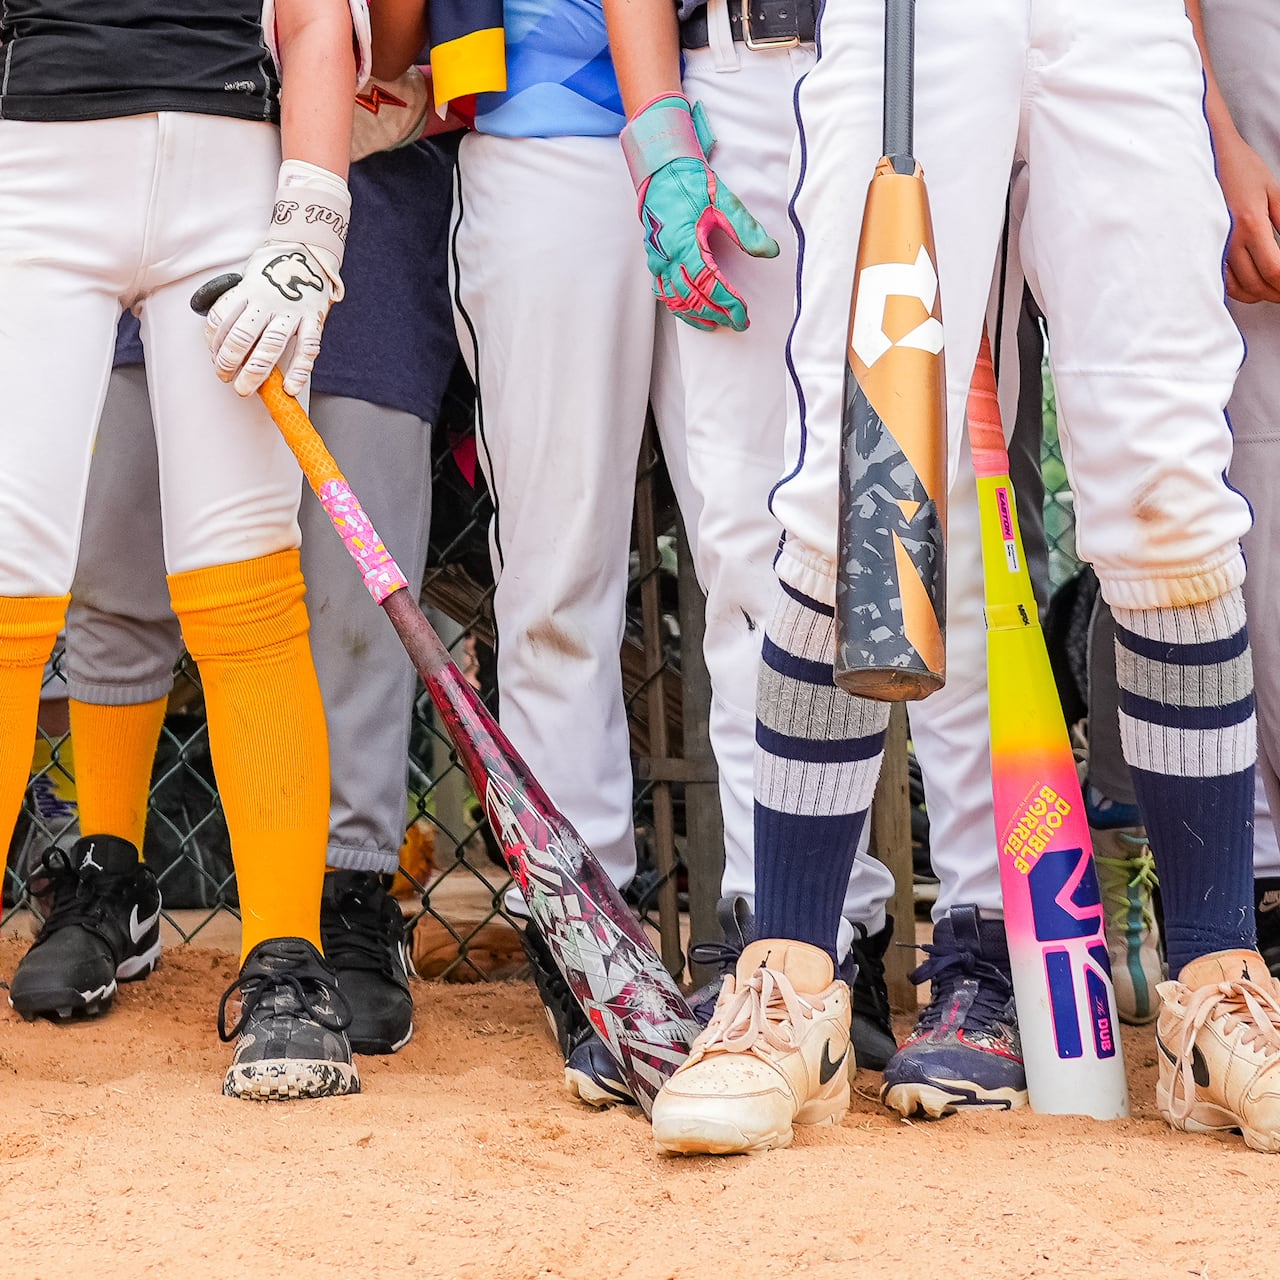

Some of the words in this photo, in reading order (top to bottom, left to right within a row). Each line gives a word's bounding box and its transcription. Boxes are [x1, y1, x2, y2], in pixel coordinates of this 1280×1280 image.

[998, 490, 1011, 537] EASTON
[1003, 785, 1058, 857] BARREL
[1013, 796, 1073, 876] DOUBLE
[1097, 1017, 1113, 1053] DUB
